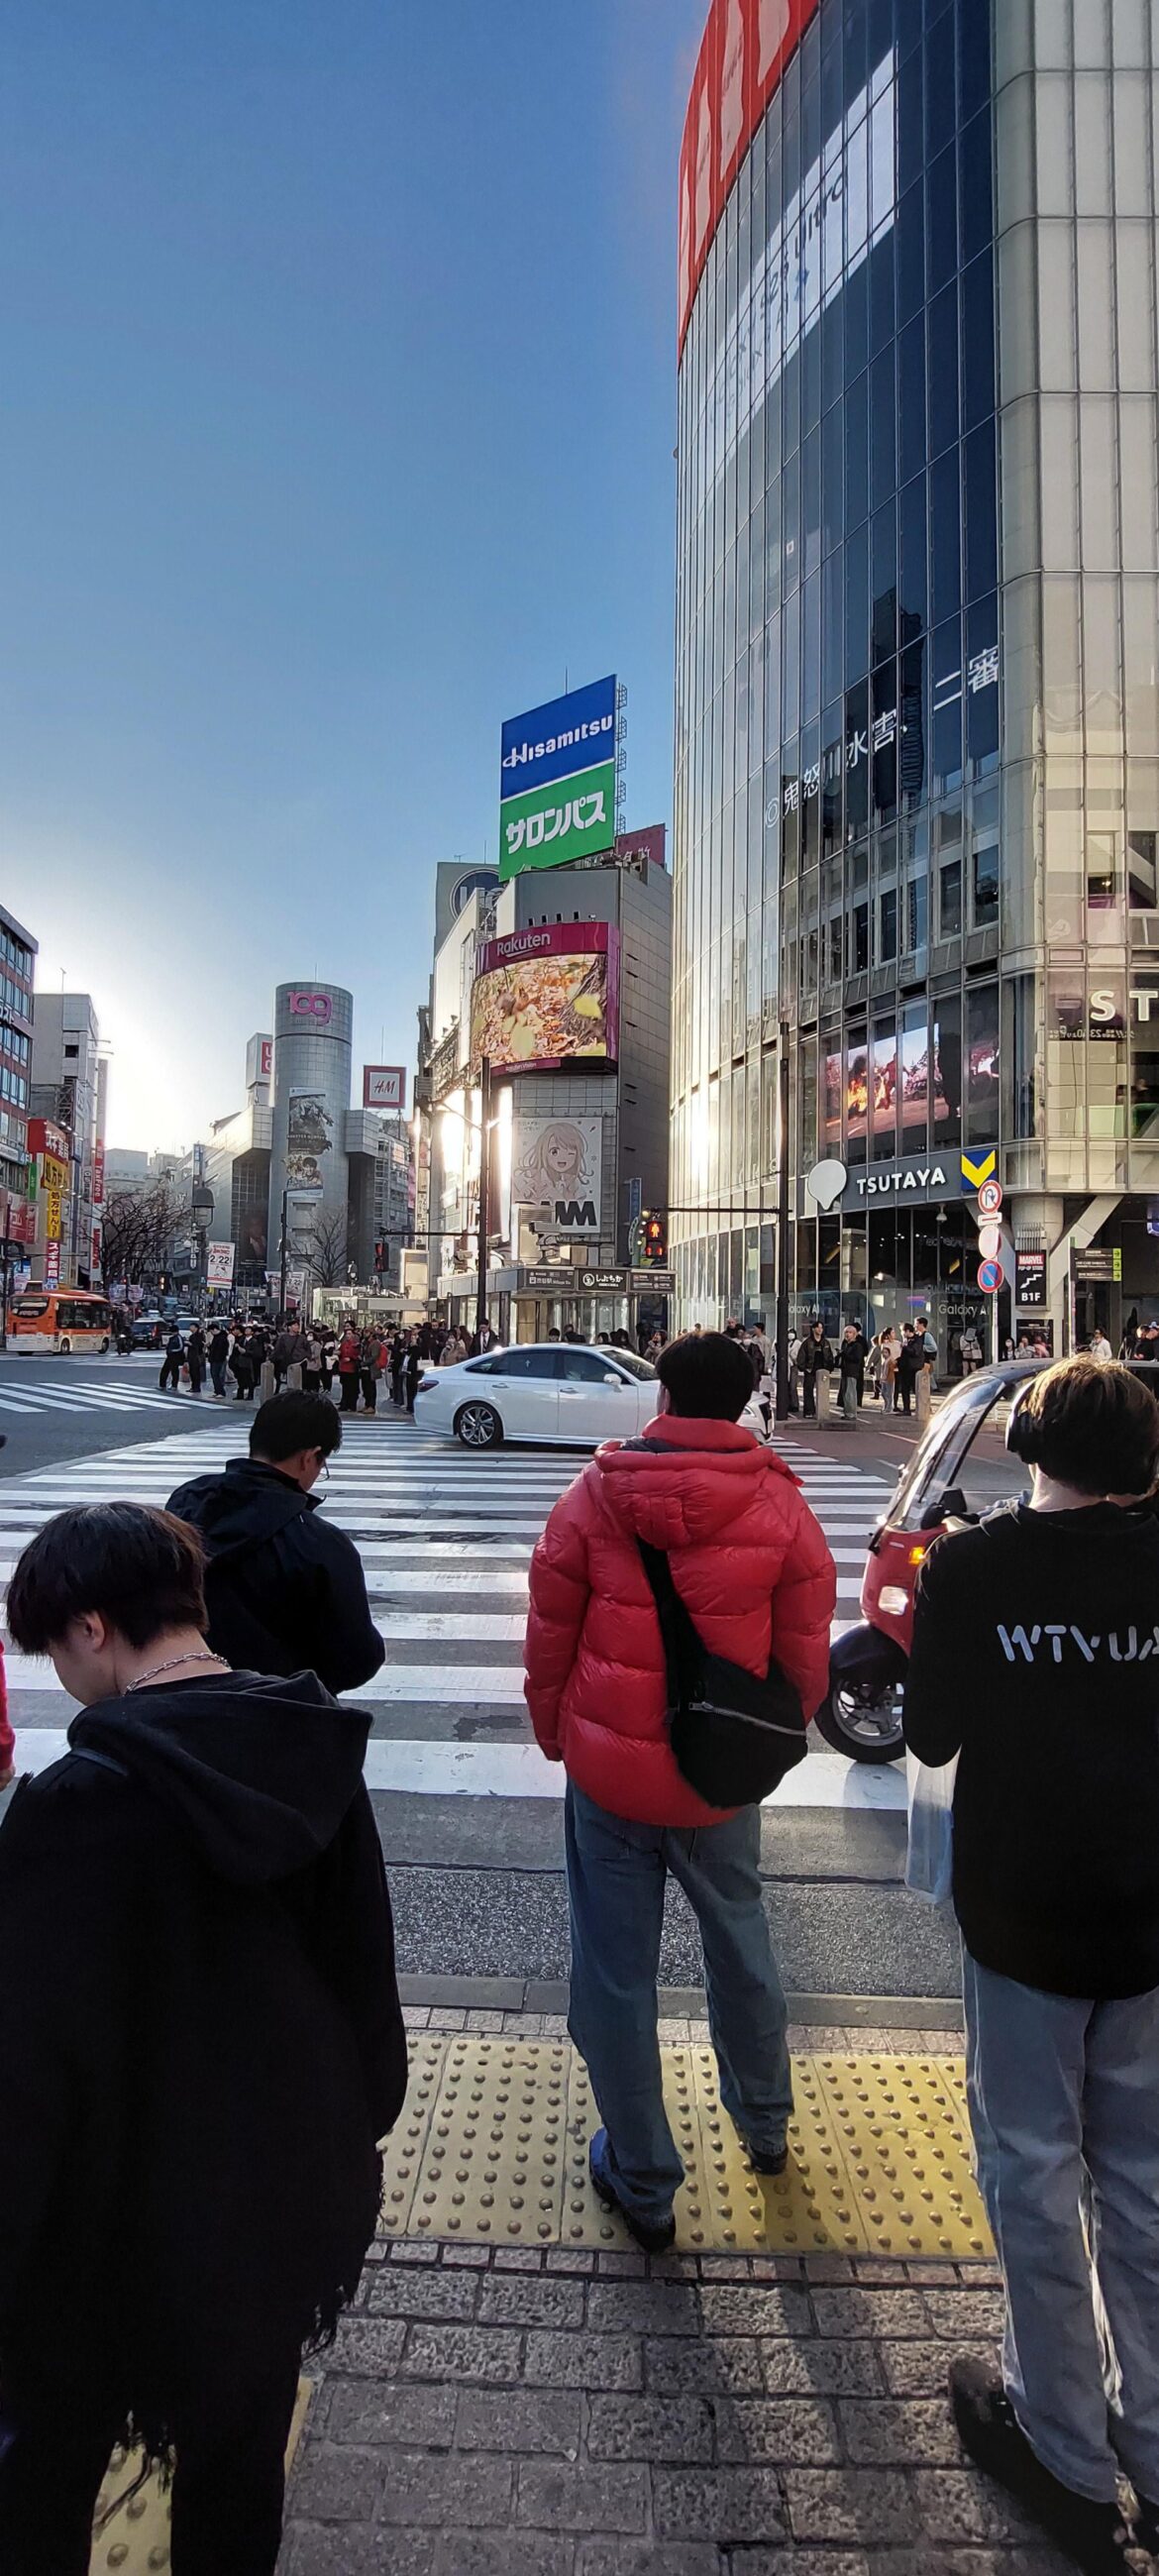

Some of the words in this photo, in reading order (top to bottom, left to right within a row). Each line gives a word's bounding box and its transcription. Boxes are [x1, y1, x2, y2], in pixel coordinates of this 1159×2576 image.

[794, 165, 848, 261] Ultra
[502, 713, 613, 768] Hisamitsu
[505, 790, 606, 855] サロンパス
[496, 931, 551, 957] Rakuten
[286, 991, 333, 1026] 109
[373, 1079, 396, 1094] H&M
[856, 1166, 947, 1195] TSUTAYA
[1018, 1255, 1044, 1264] MARVEL
[938, 1303, 978, 1318] Galaxy
[1021, 1292, 1041, 1302] B1F
